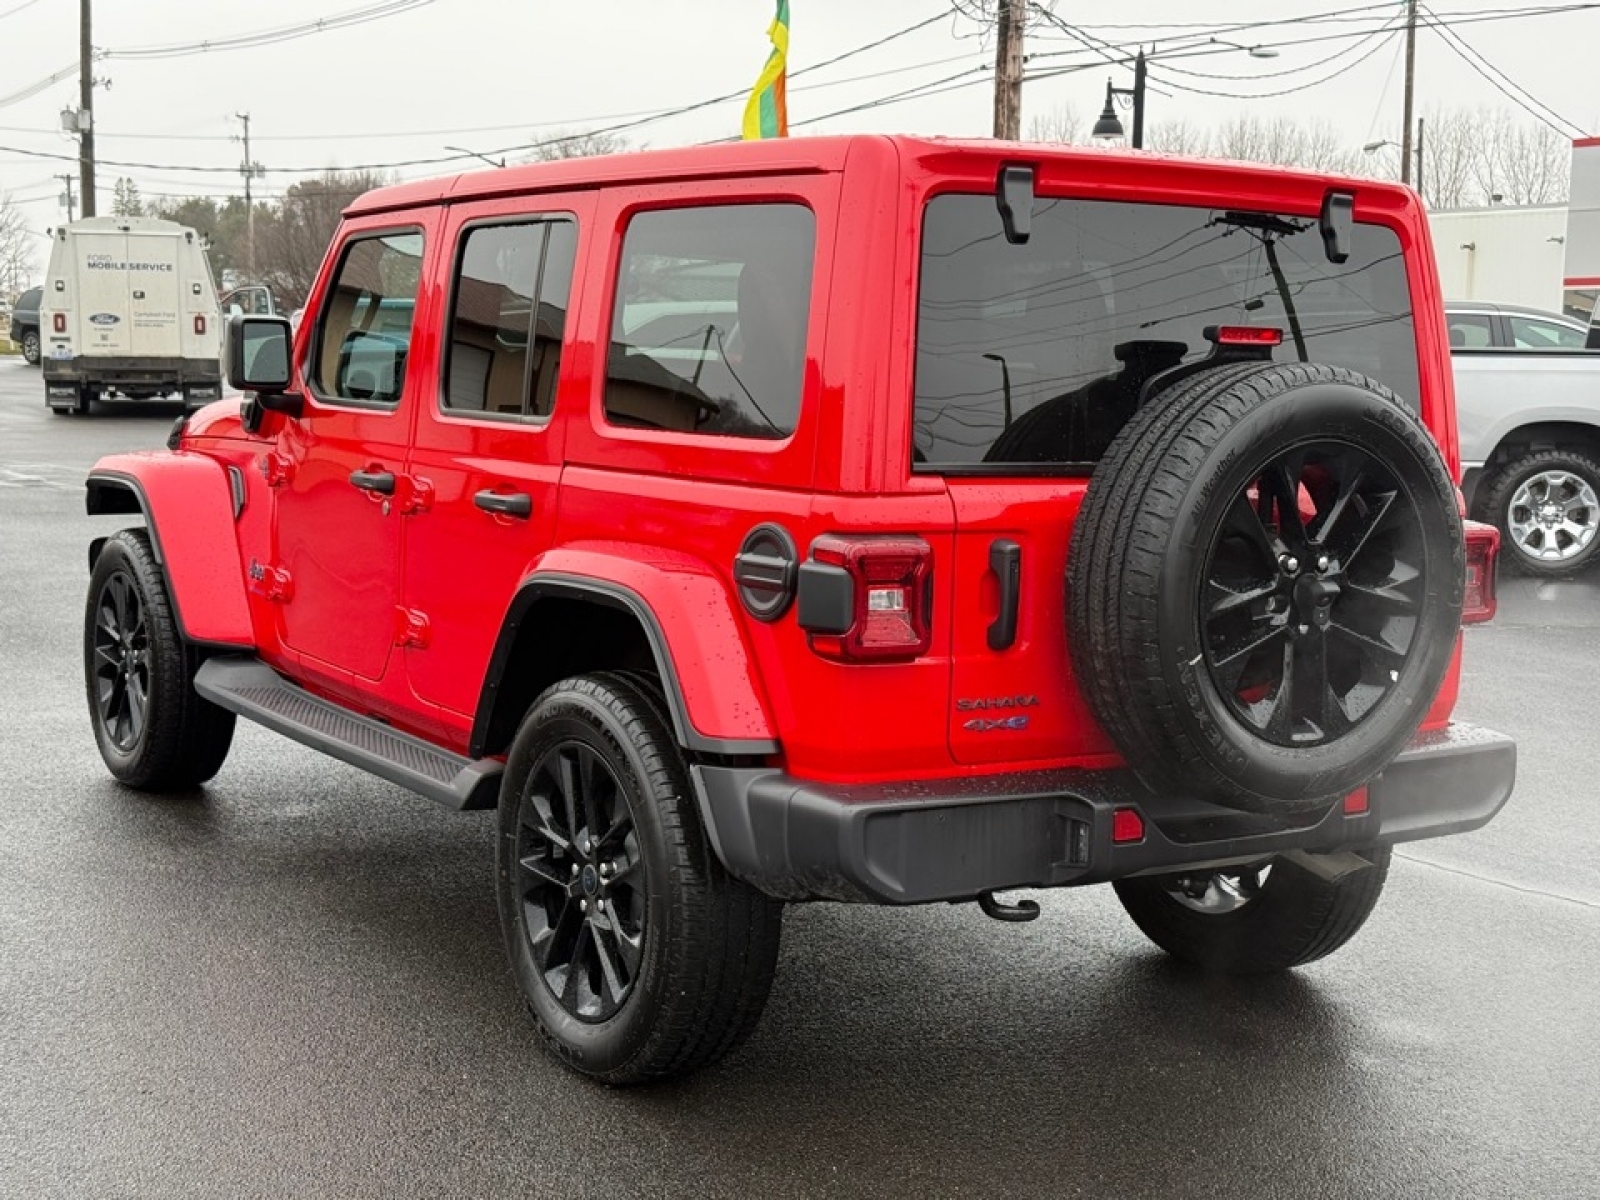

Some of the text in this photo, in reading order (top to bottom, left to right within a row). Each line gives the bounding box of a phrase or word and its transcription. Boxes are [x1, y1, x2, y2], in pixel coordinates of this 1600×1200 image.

[88, 261, 173, 272] MOBILE SERVICE
[956, 694, 1040, 711] SAHARA
